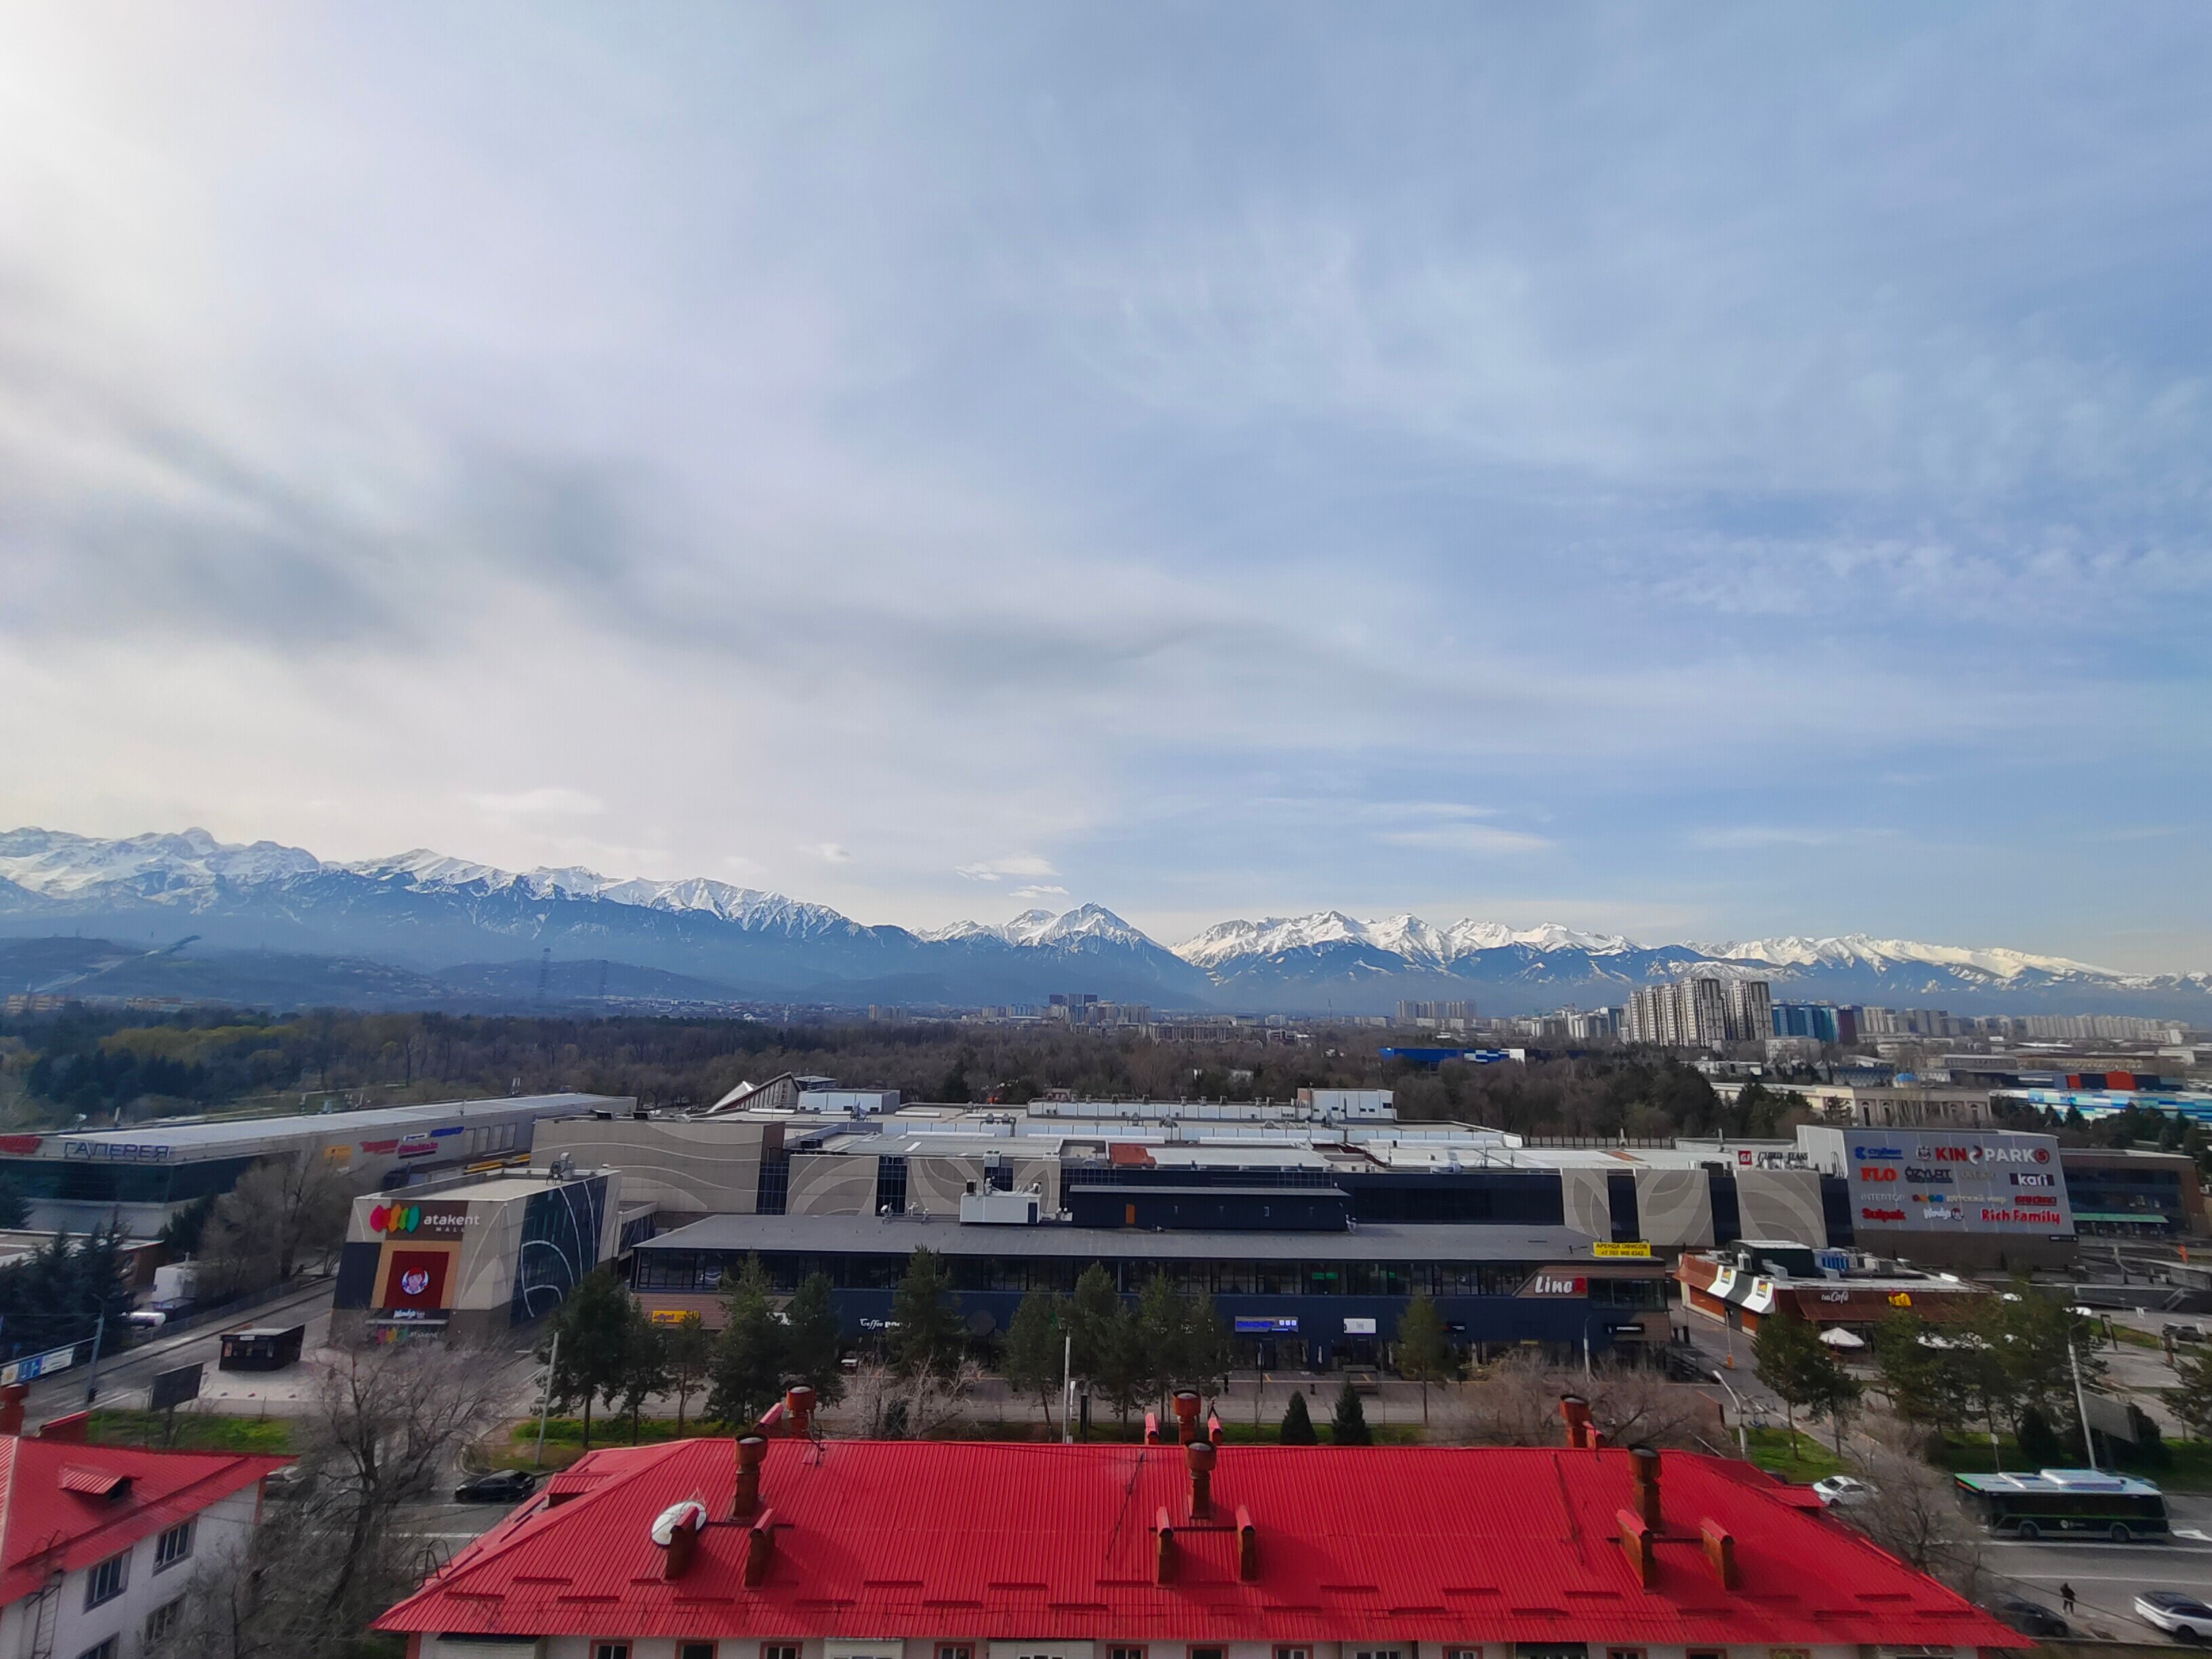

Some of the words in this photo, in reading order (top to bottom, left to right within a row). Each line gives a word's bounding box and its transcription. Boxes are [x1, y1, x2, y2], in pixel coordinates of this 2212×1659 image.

[64, 1141, 169, 1159] ГАЛЕРЕЯ
[1860, 1167, 1898, 1182] FLO
[2018, 1174, 2047, 1186] kari
[1860, 1193, 1905, 1202] INTERTOP
[424, 1214, 480, 1226] atakent
[1981, 1209, 2010, 1223] Rich
[2013, 1209, 2061, 1225] Family
